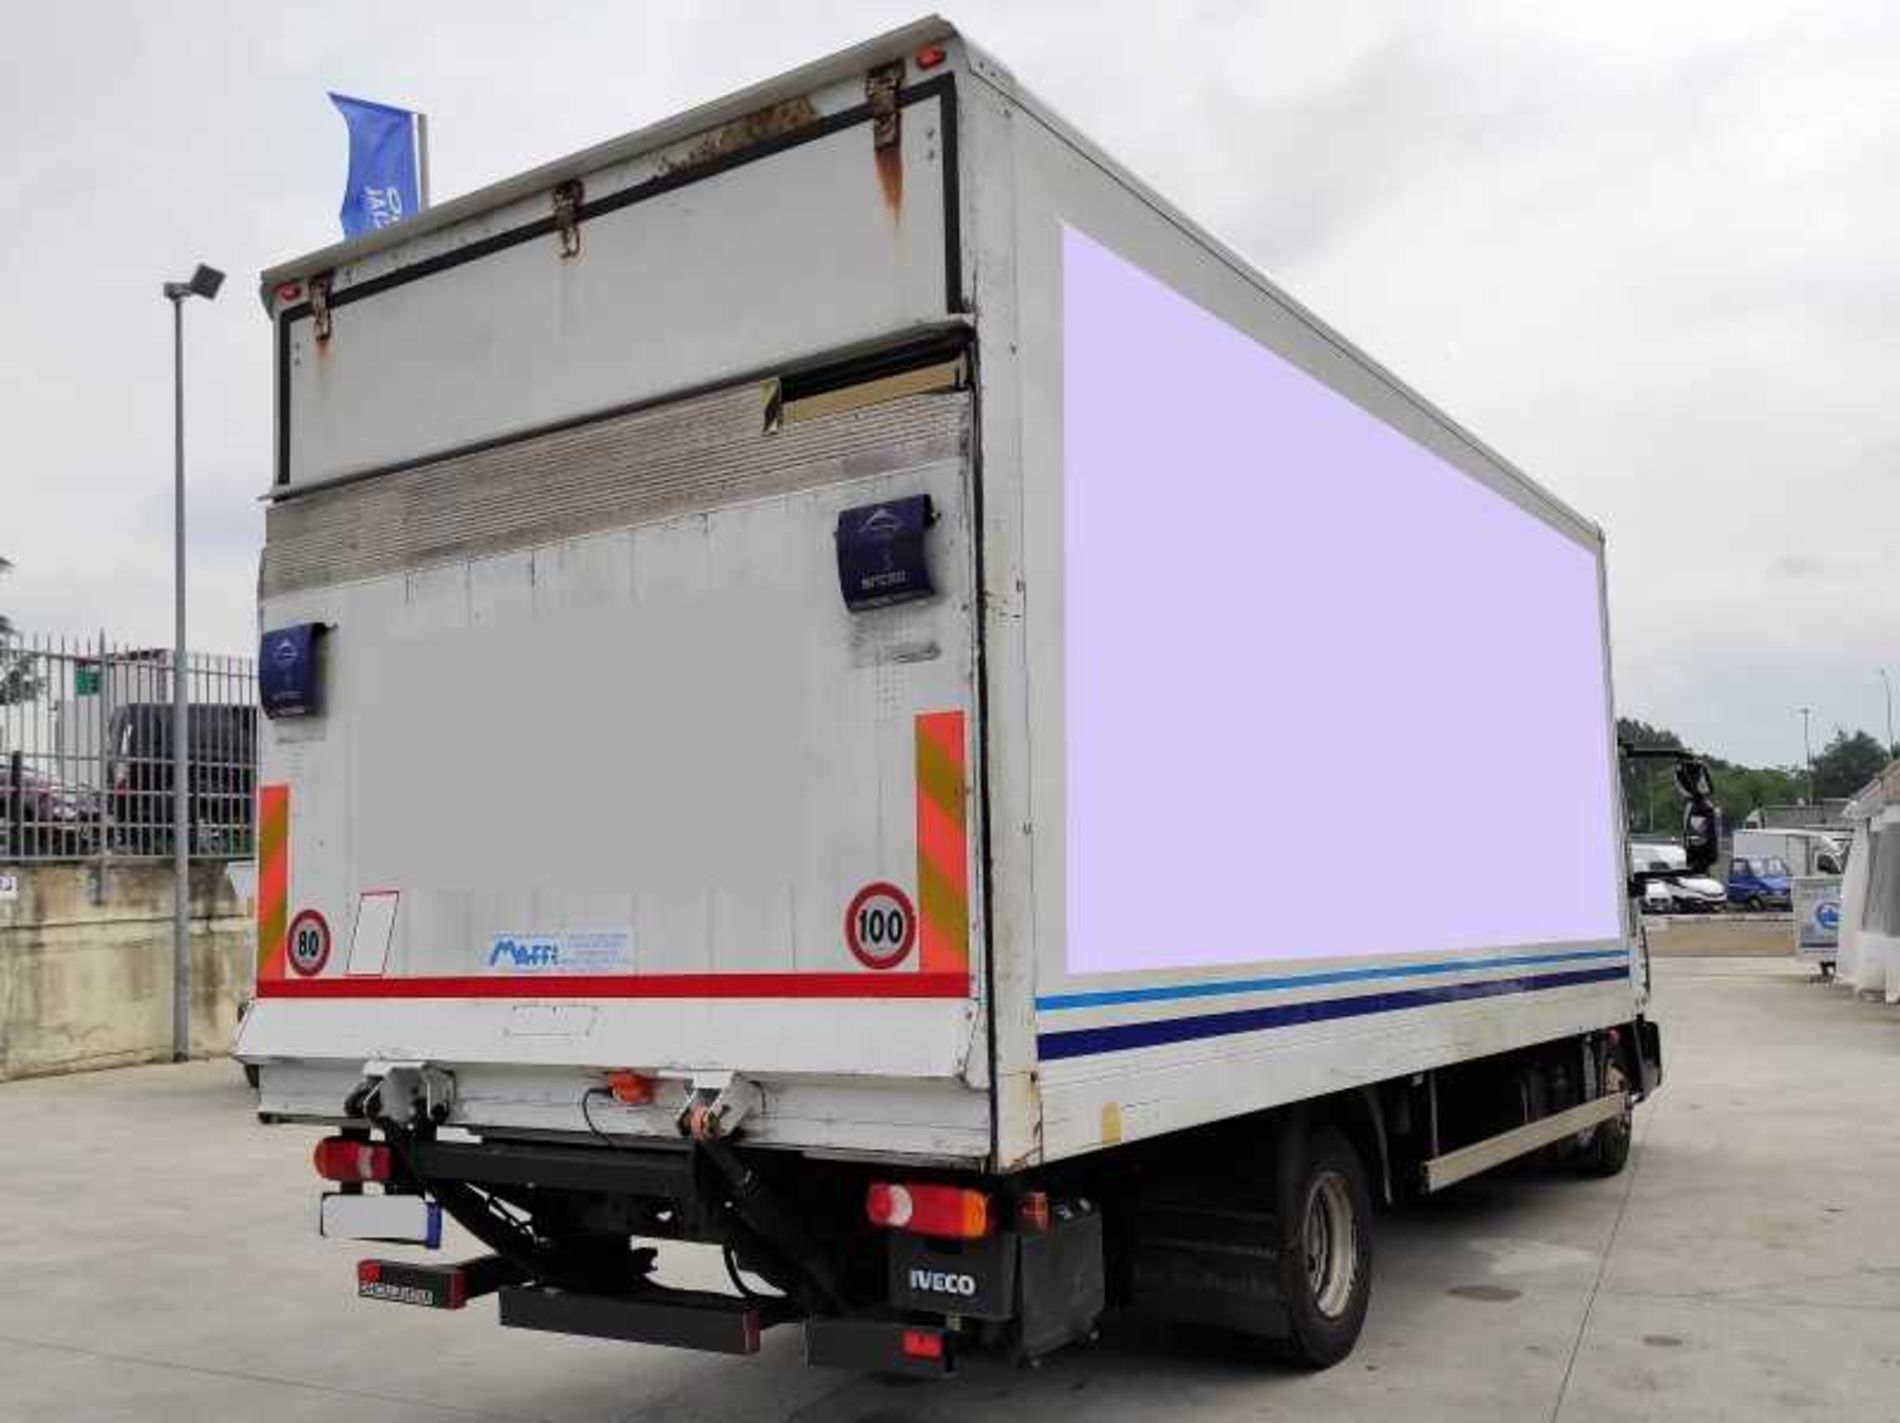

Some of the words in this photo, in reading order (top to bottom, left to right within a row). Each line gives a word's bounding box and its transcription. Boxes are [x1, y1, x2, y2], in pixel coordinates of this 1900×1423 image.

[859, 908, 903, 944] 100
[299, 930, 319, 957] 80
[911, 1269, 976, 1296] IVECO
